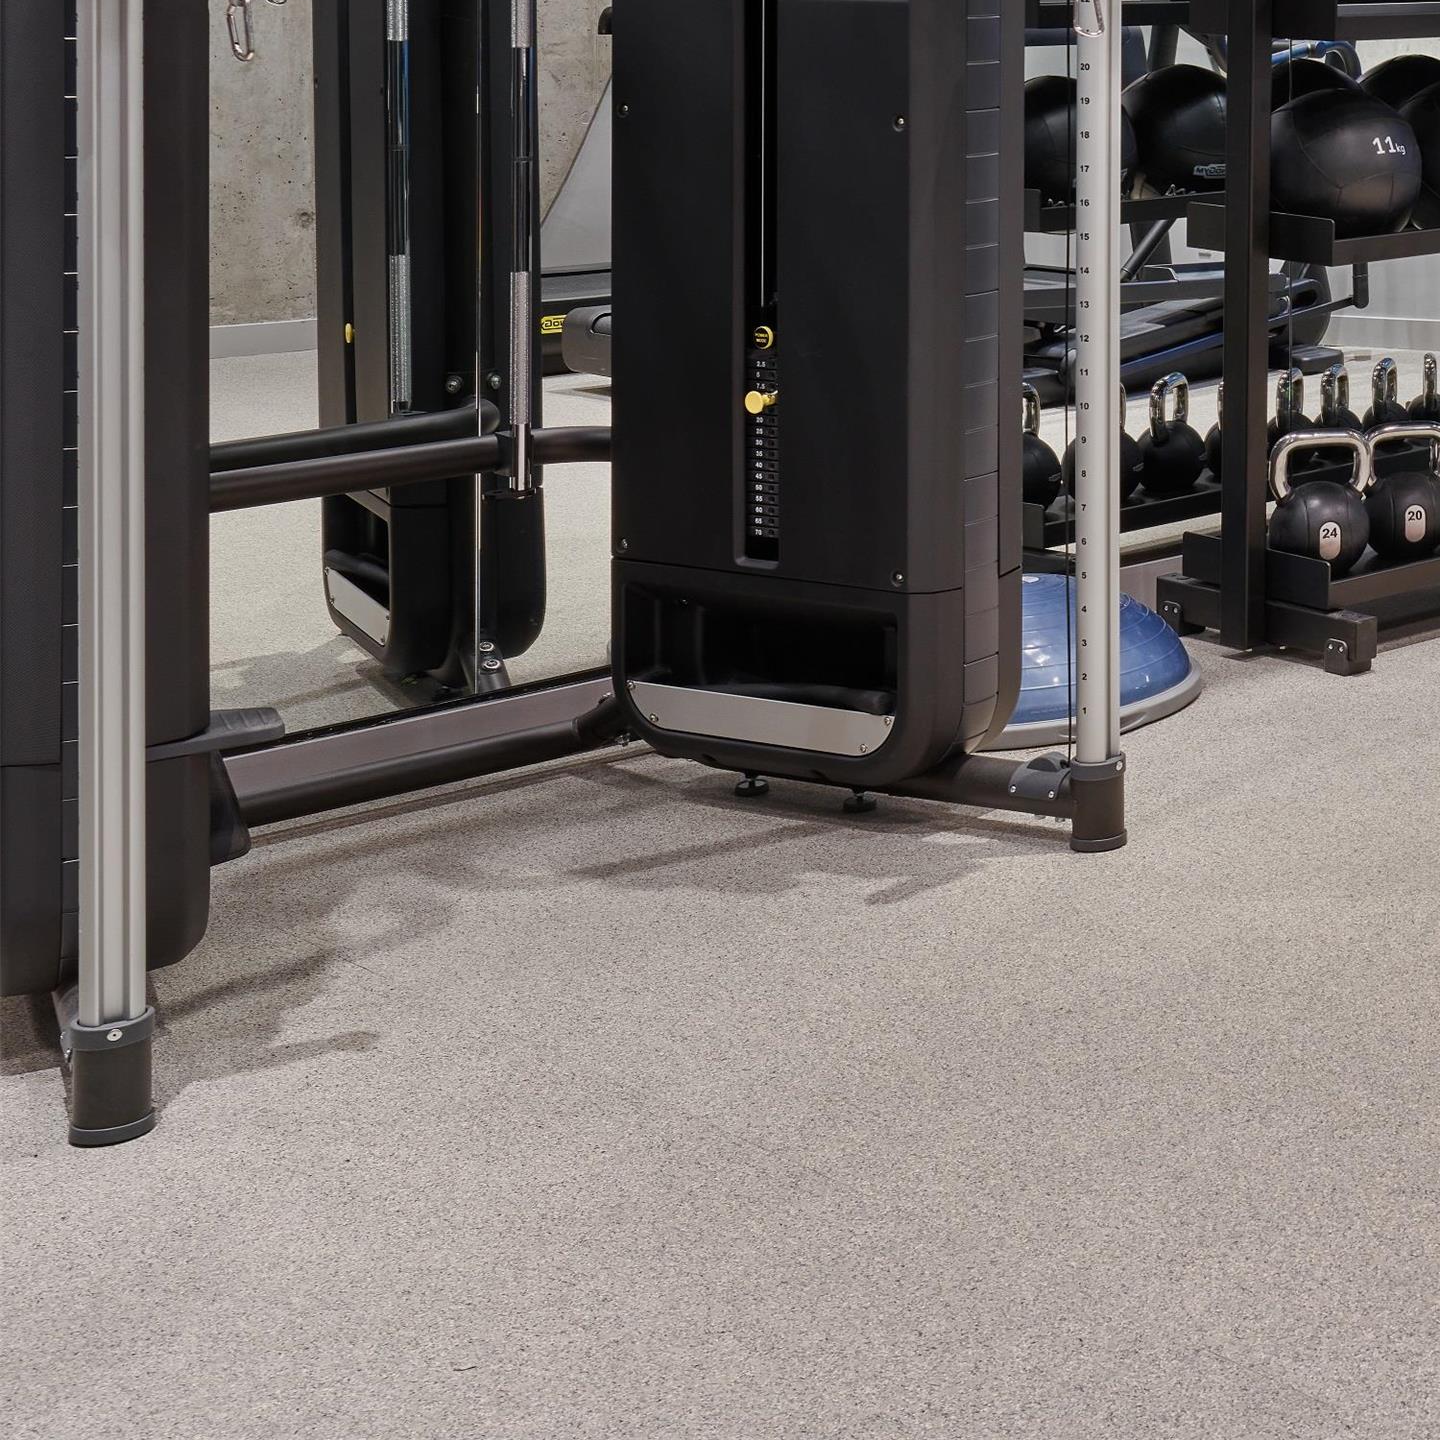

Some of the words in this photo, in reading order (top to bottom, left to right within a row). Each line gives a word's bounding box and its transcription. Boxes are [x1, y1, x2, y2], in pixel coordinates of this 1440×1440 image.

[1080, 63, 1090, 71] 20
[1080, 97, 1090, 105] 19
[1080, 131, 1090, 139] 18
[1080, 165, 1090, 173] 17
[1080, 199, 1090, 207] 16
[1080, 233, 1090, 241] 15
[1080, 267, 1090, 275] 14
[1080, 300, 1090, 308] 13
[1080, 334, 1090, 342] 12
[1080, 368, 1090, 376] 11
[1080, 402, 1090, 410] 10
[1081, 436, 1087, 444] 9
[1081, 470, 1087, 478] 8
[1081, 504, 1087, 512] 7
[1407, 510, 1423, 522] 20
[1322, 527, 1338, 539] 24
[1081, 537, 1087, 545] 6
[1081, 571, 1087, 579] 5
[1081, 605, 1087, 613] 4
[1081, 639, 1087, 647] 3
[1081, 673, 1087, 681] 2
[1081, 707, 1087, 715] 1
